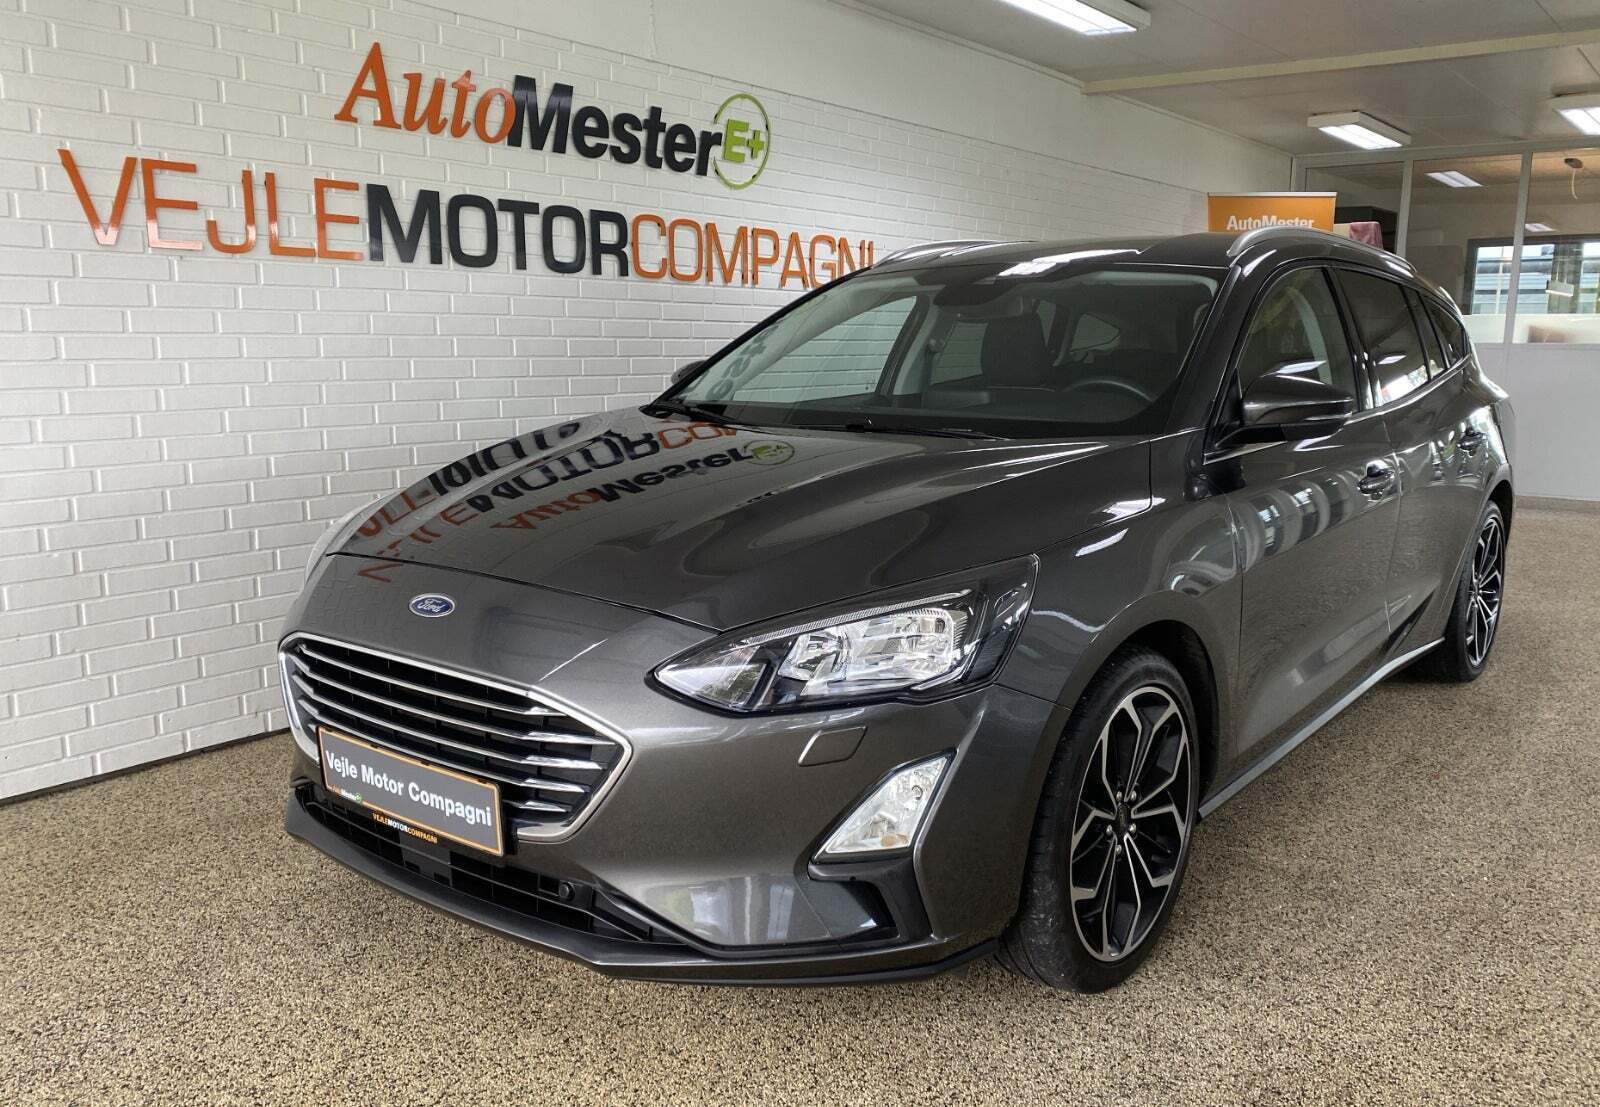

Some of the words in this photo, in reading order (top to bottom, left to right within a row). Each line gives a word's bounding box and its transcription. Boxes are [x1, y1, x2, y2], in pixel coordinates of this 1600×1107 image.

[334, 41, 721, 177] AutoMester
[325, 751, 358, 779] Vejle
[361, 764, 404, 796] Motor
[408, 782, 493, 827] Compagni
